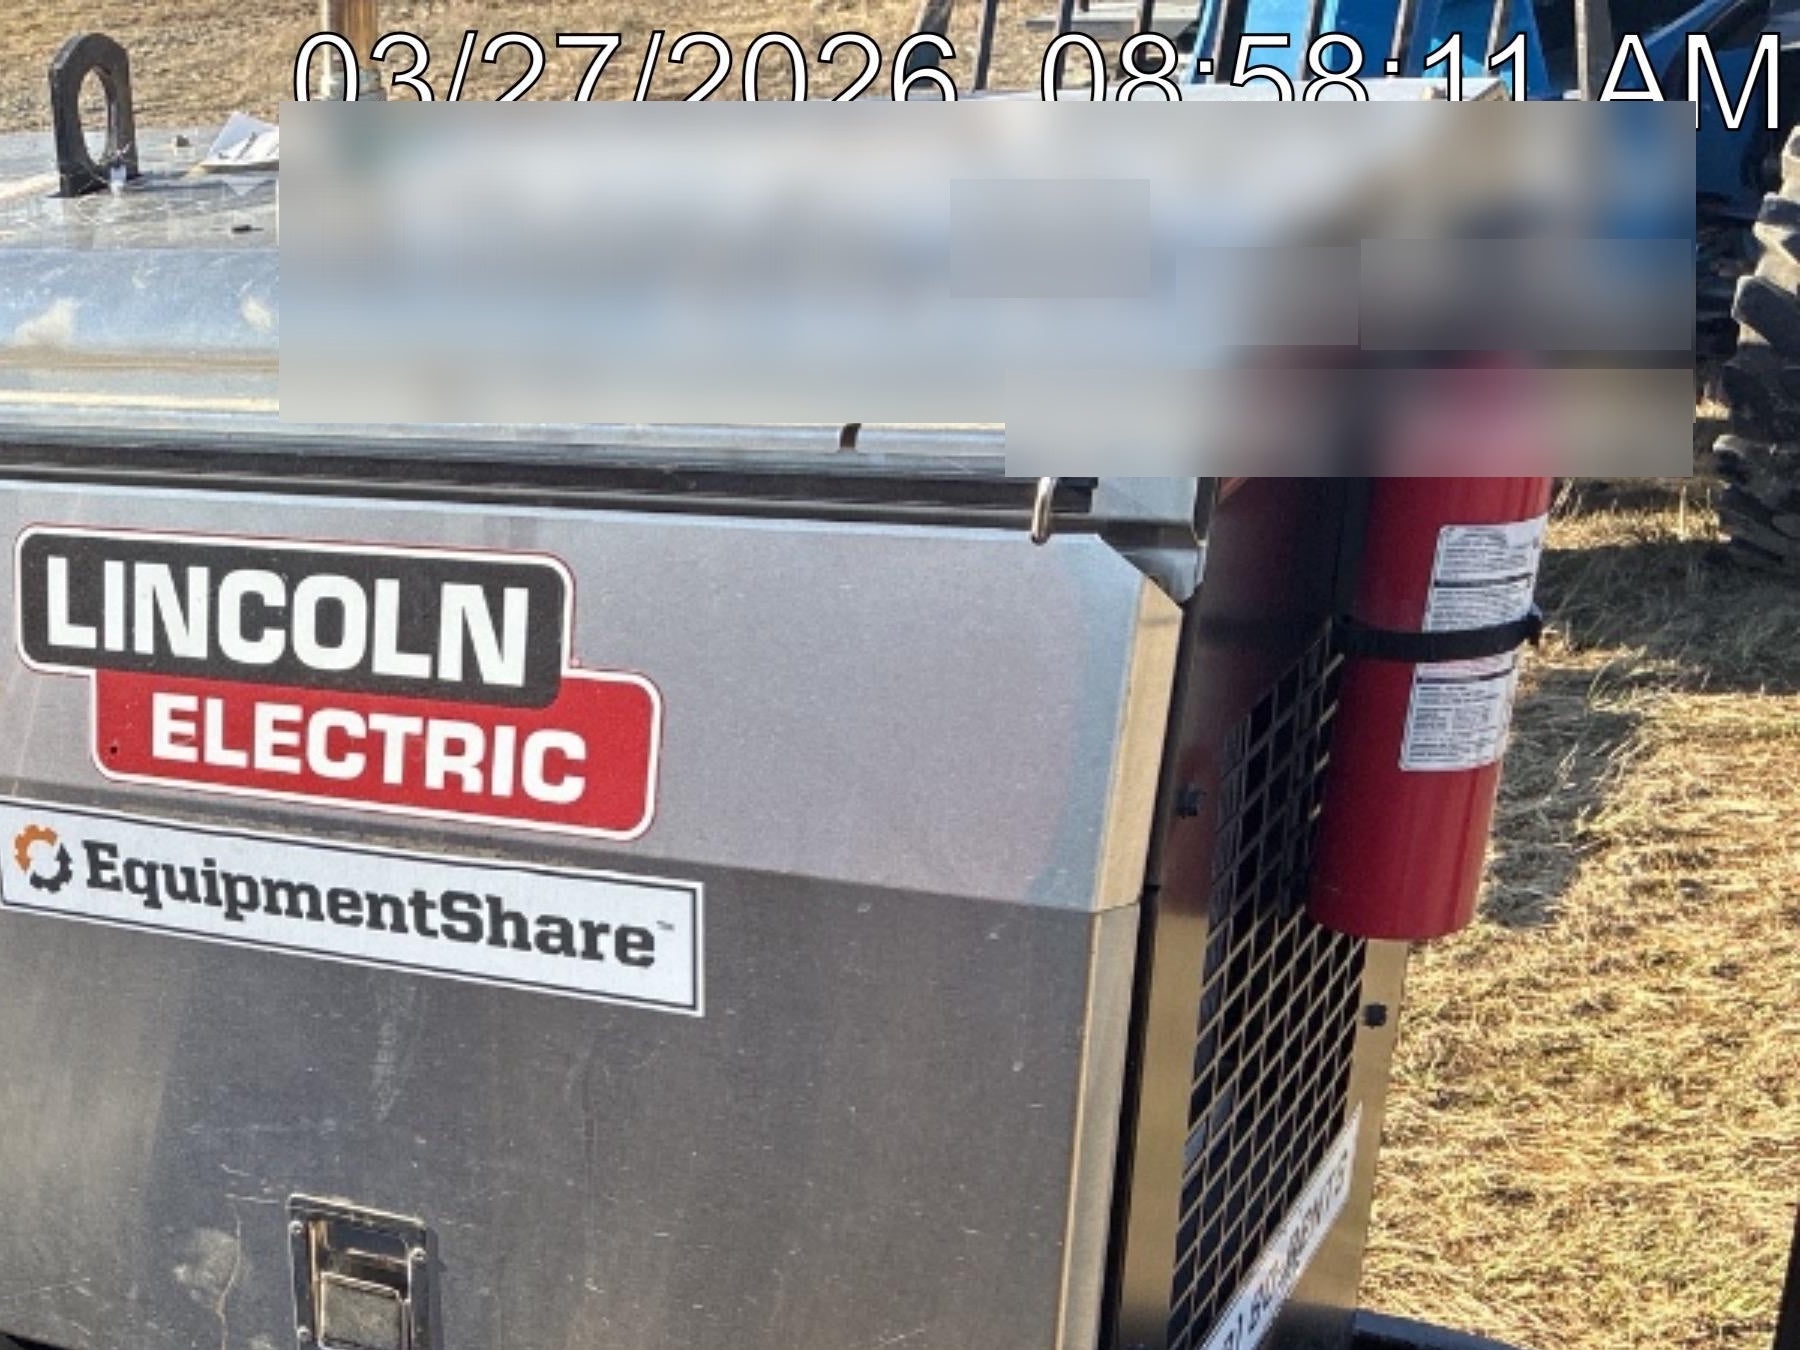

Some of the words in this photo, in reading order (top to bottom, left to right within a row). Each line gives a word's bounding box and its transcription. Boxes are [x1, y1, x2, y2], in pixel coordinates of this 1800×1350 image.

[46, 556, 530, 688] LINCOLN
[151, 691, 587, 805] ELECTRIC
[81, 839, 657, 968] EquipmentShare
